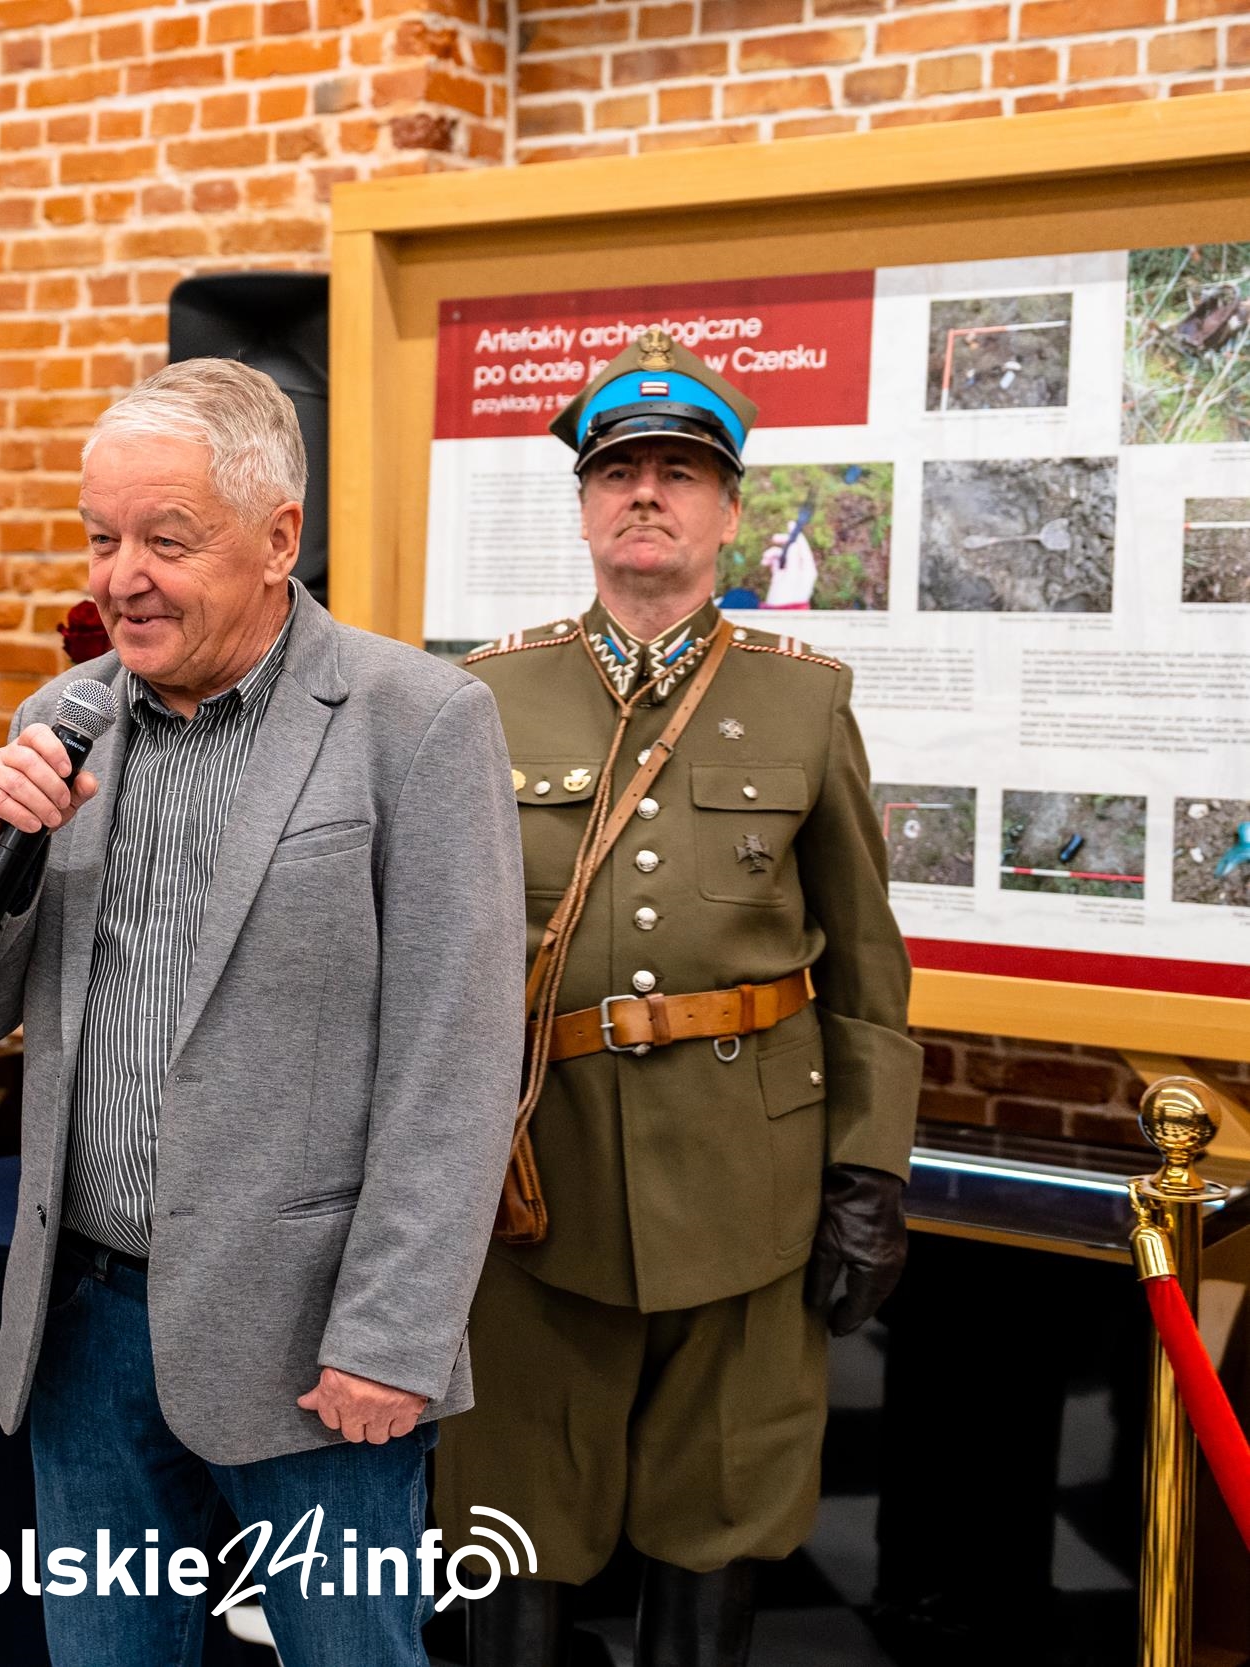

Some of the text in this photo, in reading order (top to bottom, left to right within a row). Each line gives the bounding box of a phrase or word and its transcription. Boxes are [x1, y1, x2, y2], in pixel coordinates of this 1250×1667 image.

[475, 325, 576, 353] Artefakty
[474, 345, 827, 391] po obozie je w Czersku
